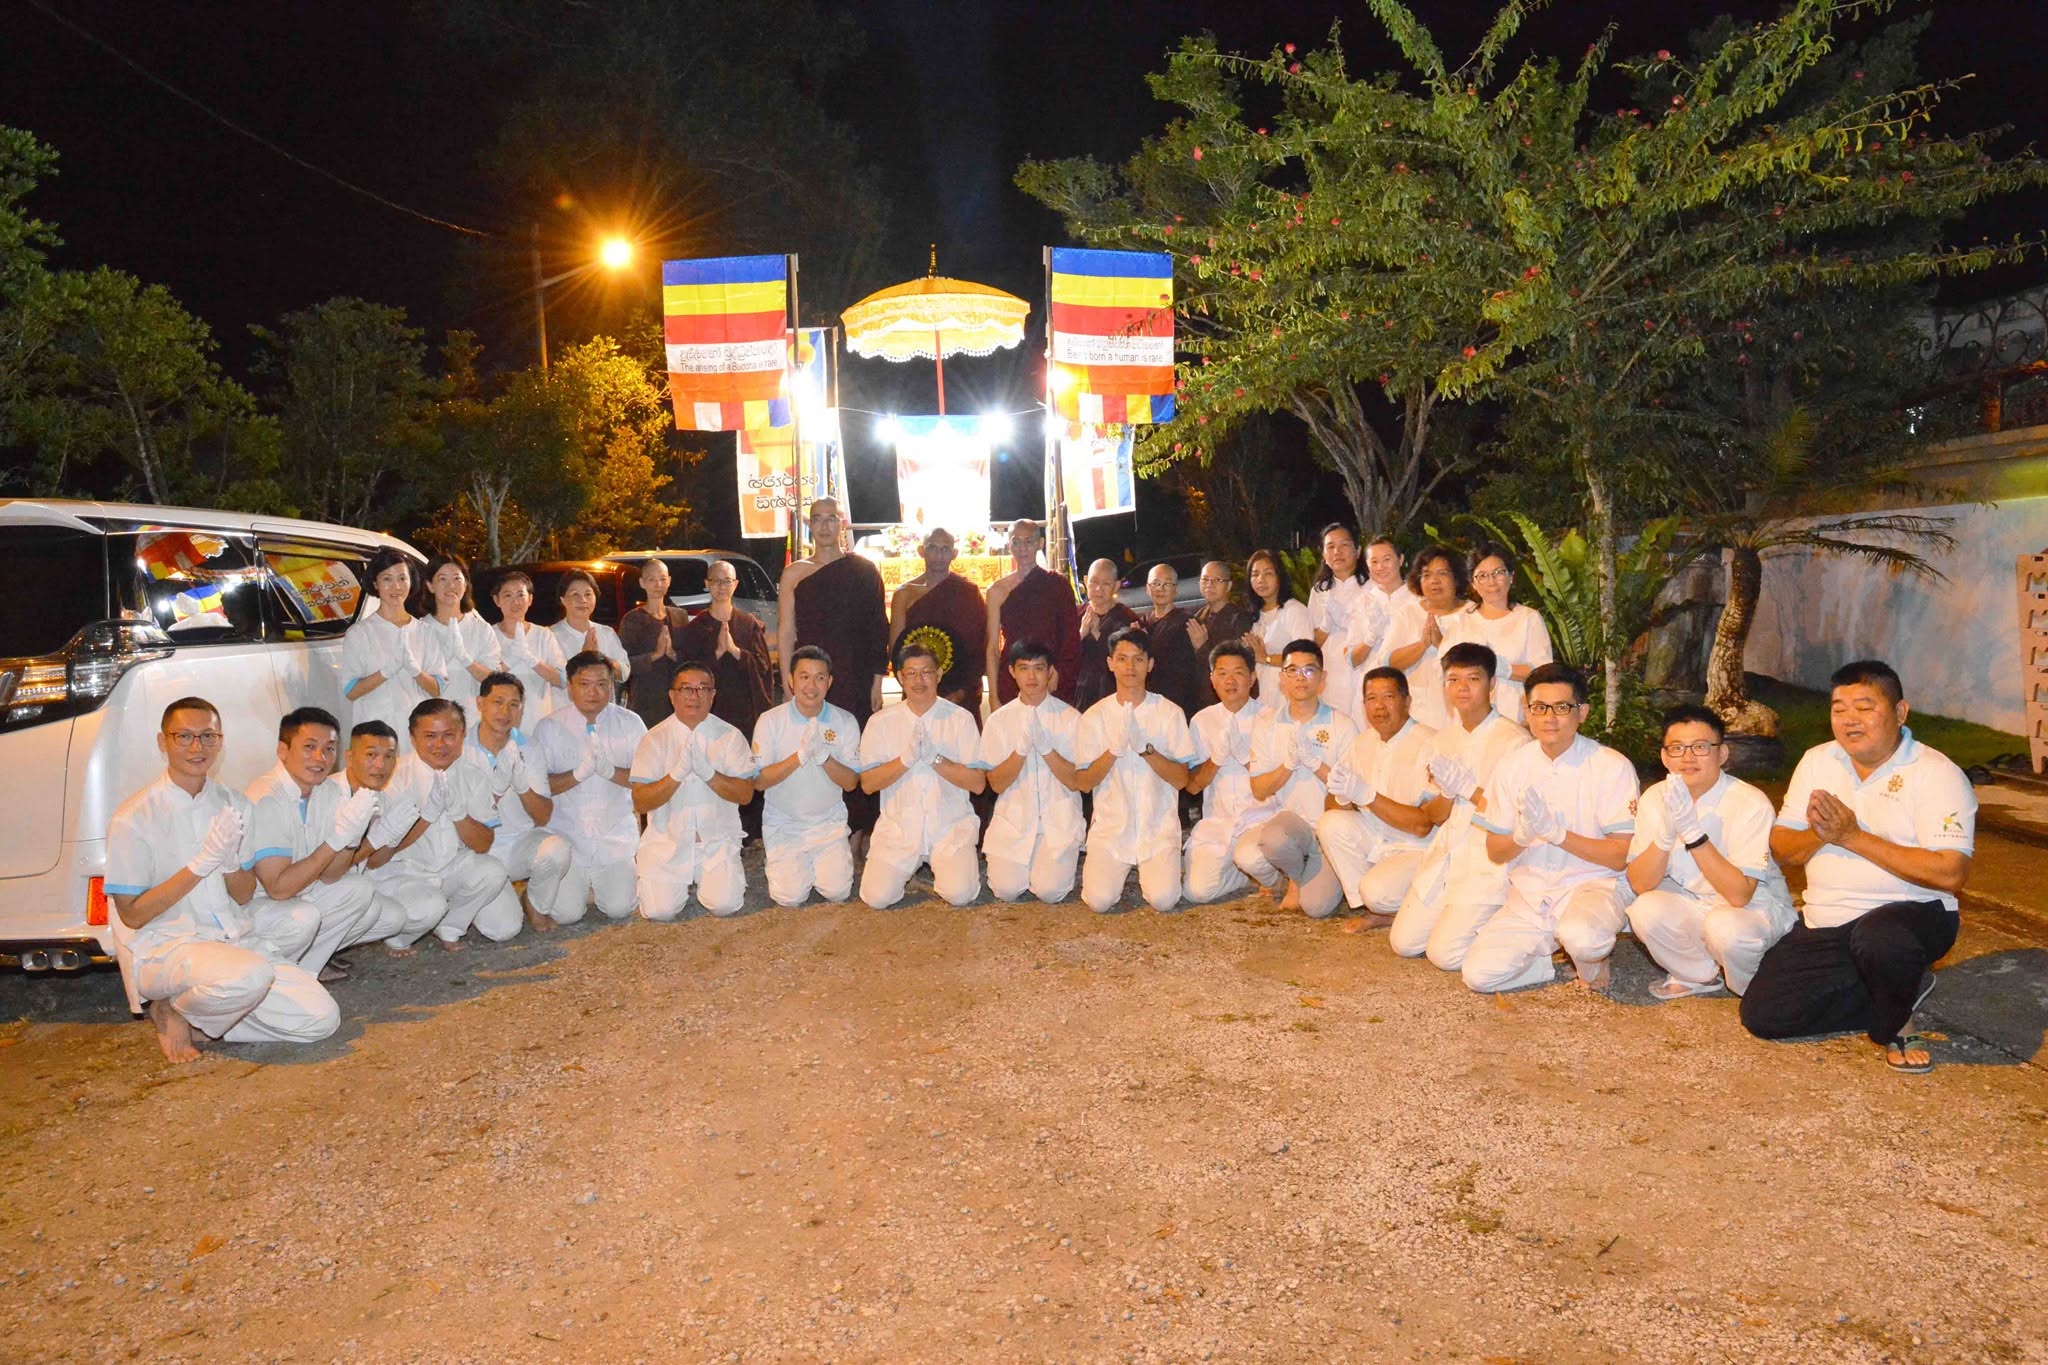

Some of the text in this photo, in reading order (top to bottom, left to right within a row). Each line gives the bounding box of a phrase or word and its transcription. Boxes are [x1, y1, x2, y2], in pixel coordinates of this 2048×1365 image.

[1089, 350, 1106, 361] born
[1108, 353, 1113, 361] a
[1115, 351, 1139, 362] human
[1149, 354, 1164, 363] rare
[680, 362, 694, 372] The
[695, 363, 718, 373] arising
[720, 362, 726, 372] of
[732, 361, 757, 372] Buddha
[764, 359, 778, 368] rare
